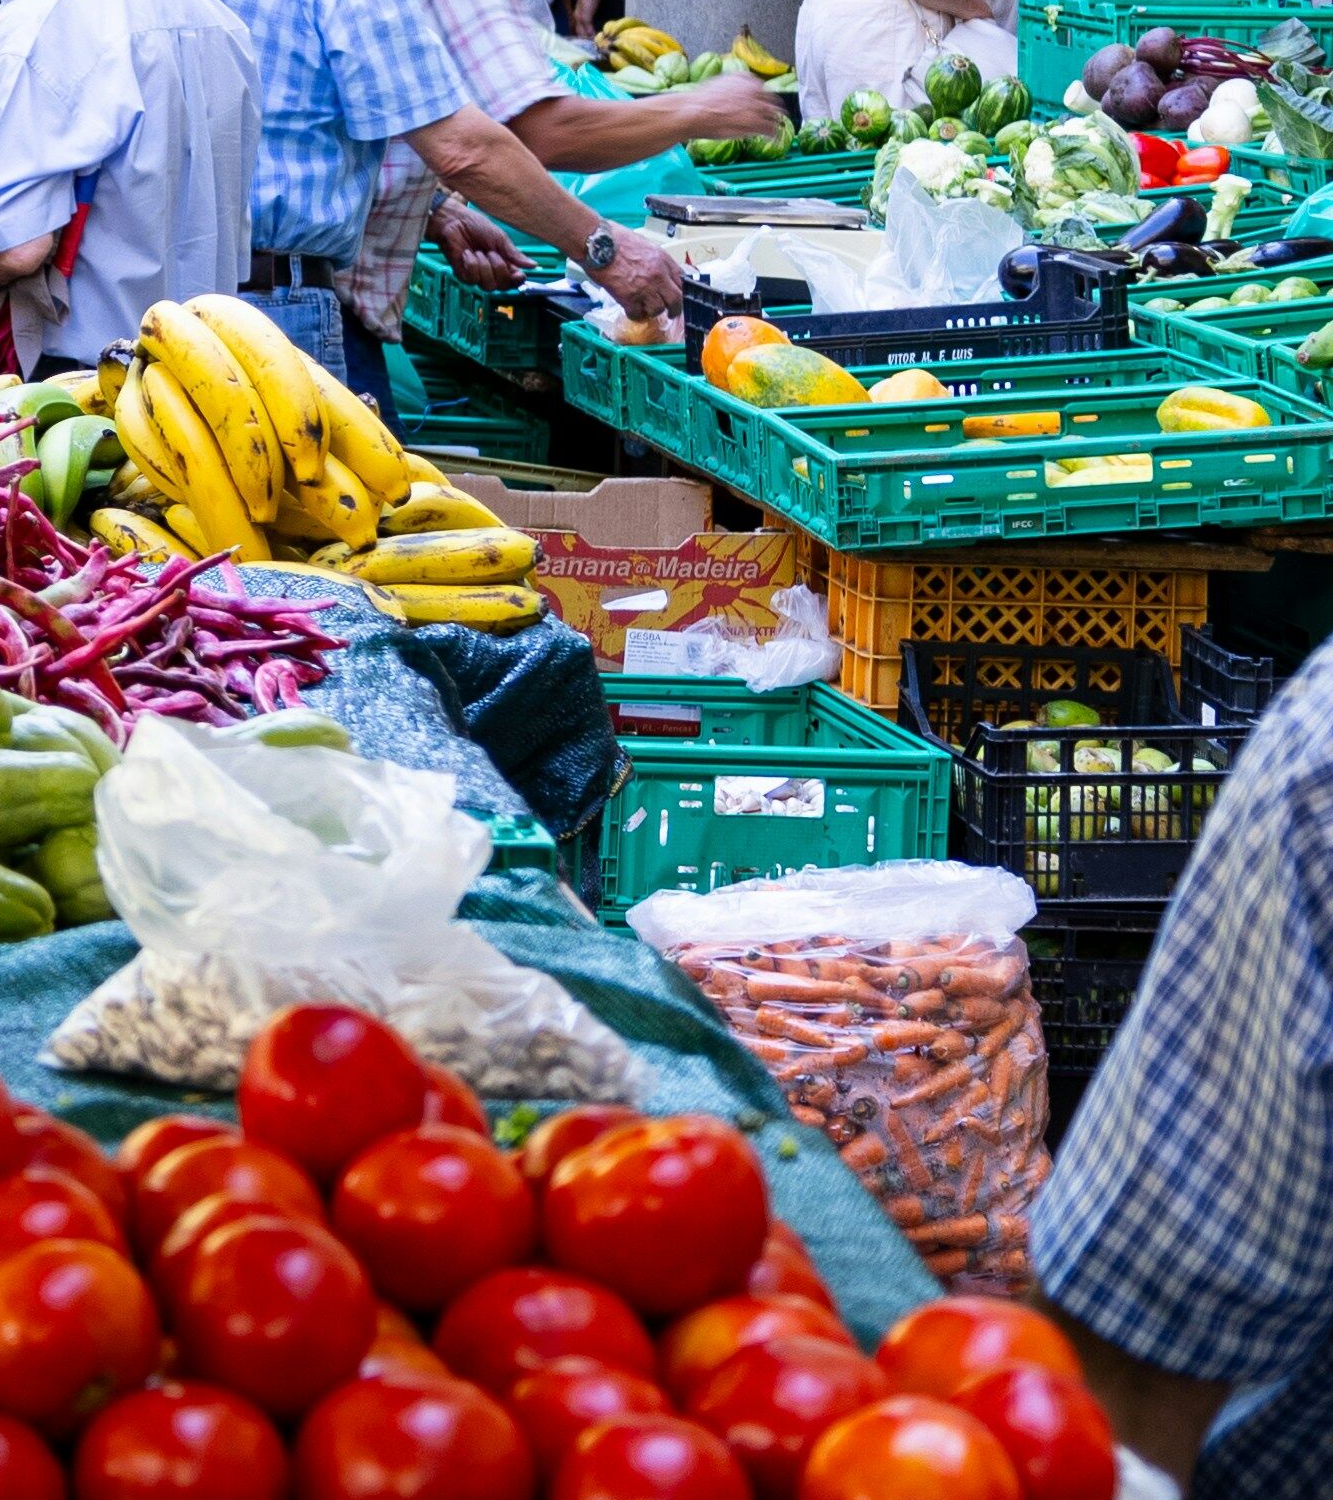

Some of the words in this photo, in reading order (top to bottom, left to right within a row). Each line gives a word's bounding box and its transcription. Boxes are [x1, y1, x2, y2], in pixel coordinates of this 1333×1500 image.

[888, 353, 916, 365] VITOR
[951, 348, 973, 360] LUIS
[536, 554, 631, 578] Banana
[635, 563, 651, 575] da
[654, 556, 761, 580] Madeira
